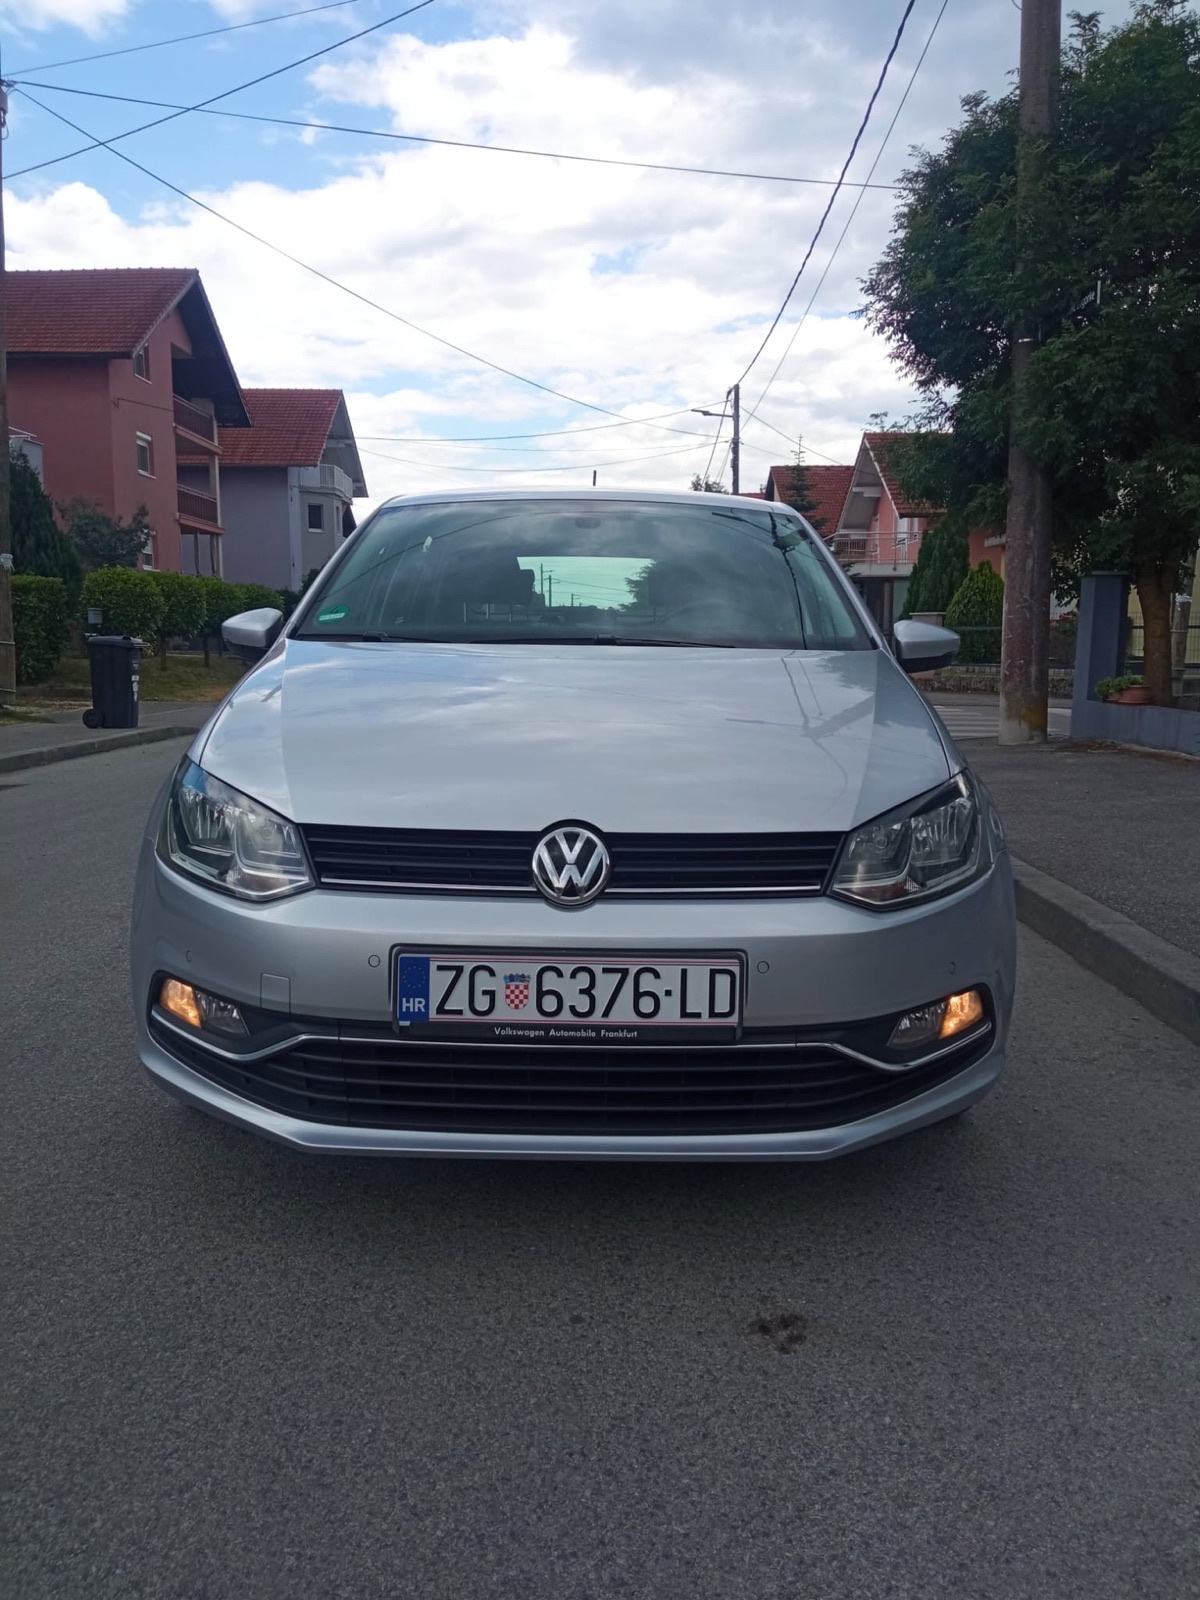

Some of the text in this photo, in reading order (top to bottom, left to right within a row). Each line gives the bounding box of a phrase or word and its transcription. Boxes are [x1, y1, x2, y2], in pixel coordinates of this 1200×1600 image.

[535, 829, 607, 899] VW
[402, 997, 426, 1012] HR
[435, 964, 497, 1017] ZG
[494, 1026, 638, 1038] Volkswagen Automobile Frankfurt
